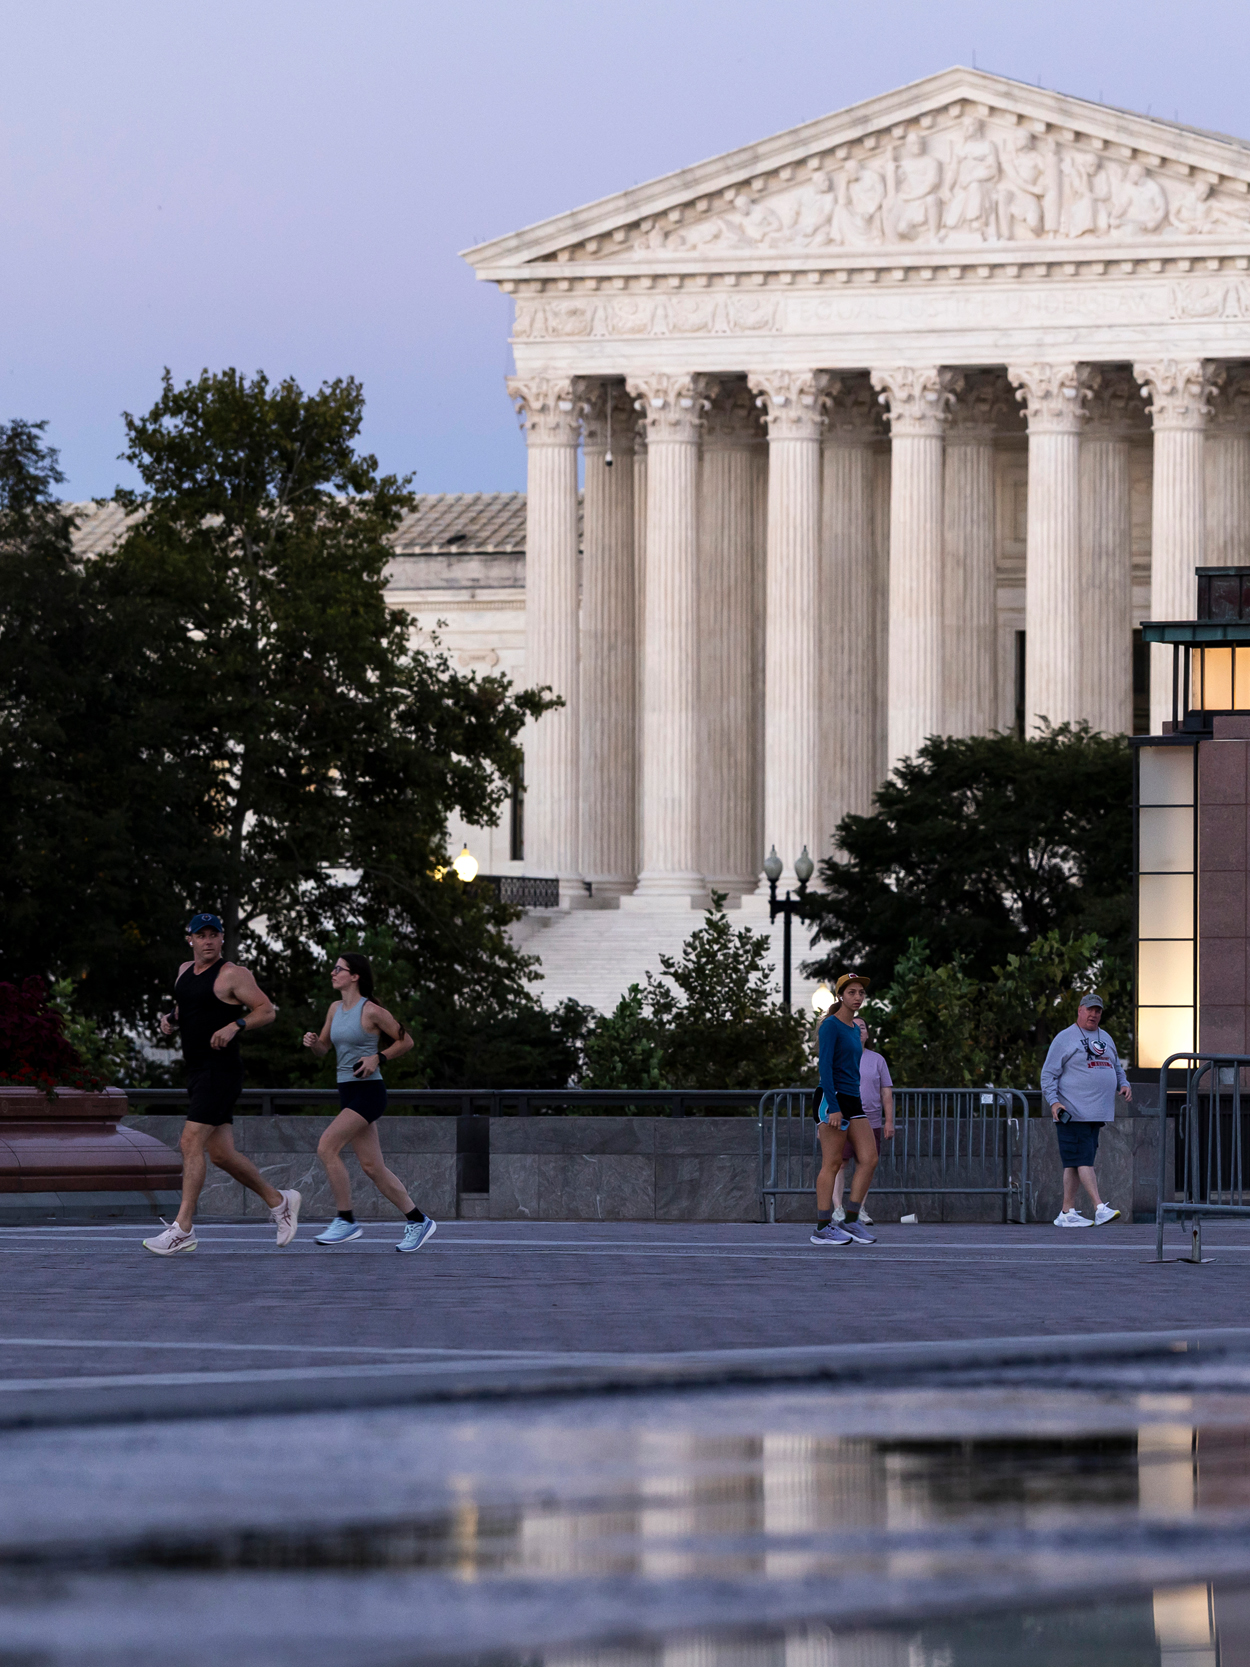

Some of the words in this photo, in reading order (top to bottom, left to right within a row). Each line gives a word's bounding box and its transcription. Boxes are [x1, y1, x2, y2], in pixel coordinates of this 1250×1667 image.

[799, 298, 888, 322] EQUAL
[892, 295, 992, 320] JUSTICE
[1006, 292, 1091, 315] UNDER
[1102, 291, 1152, 313] LAW
